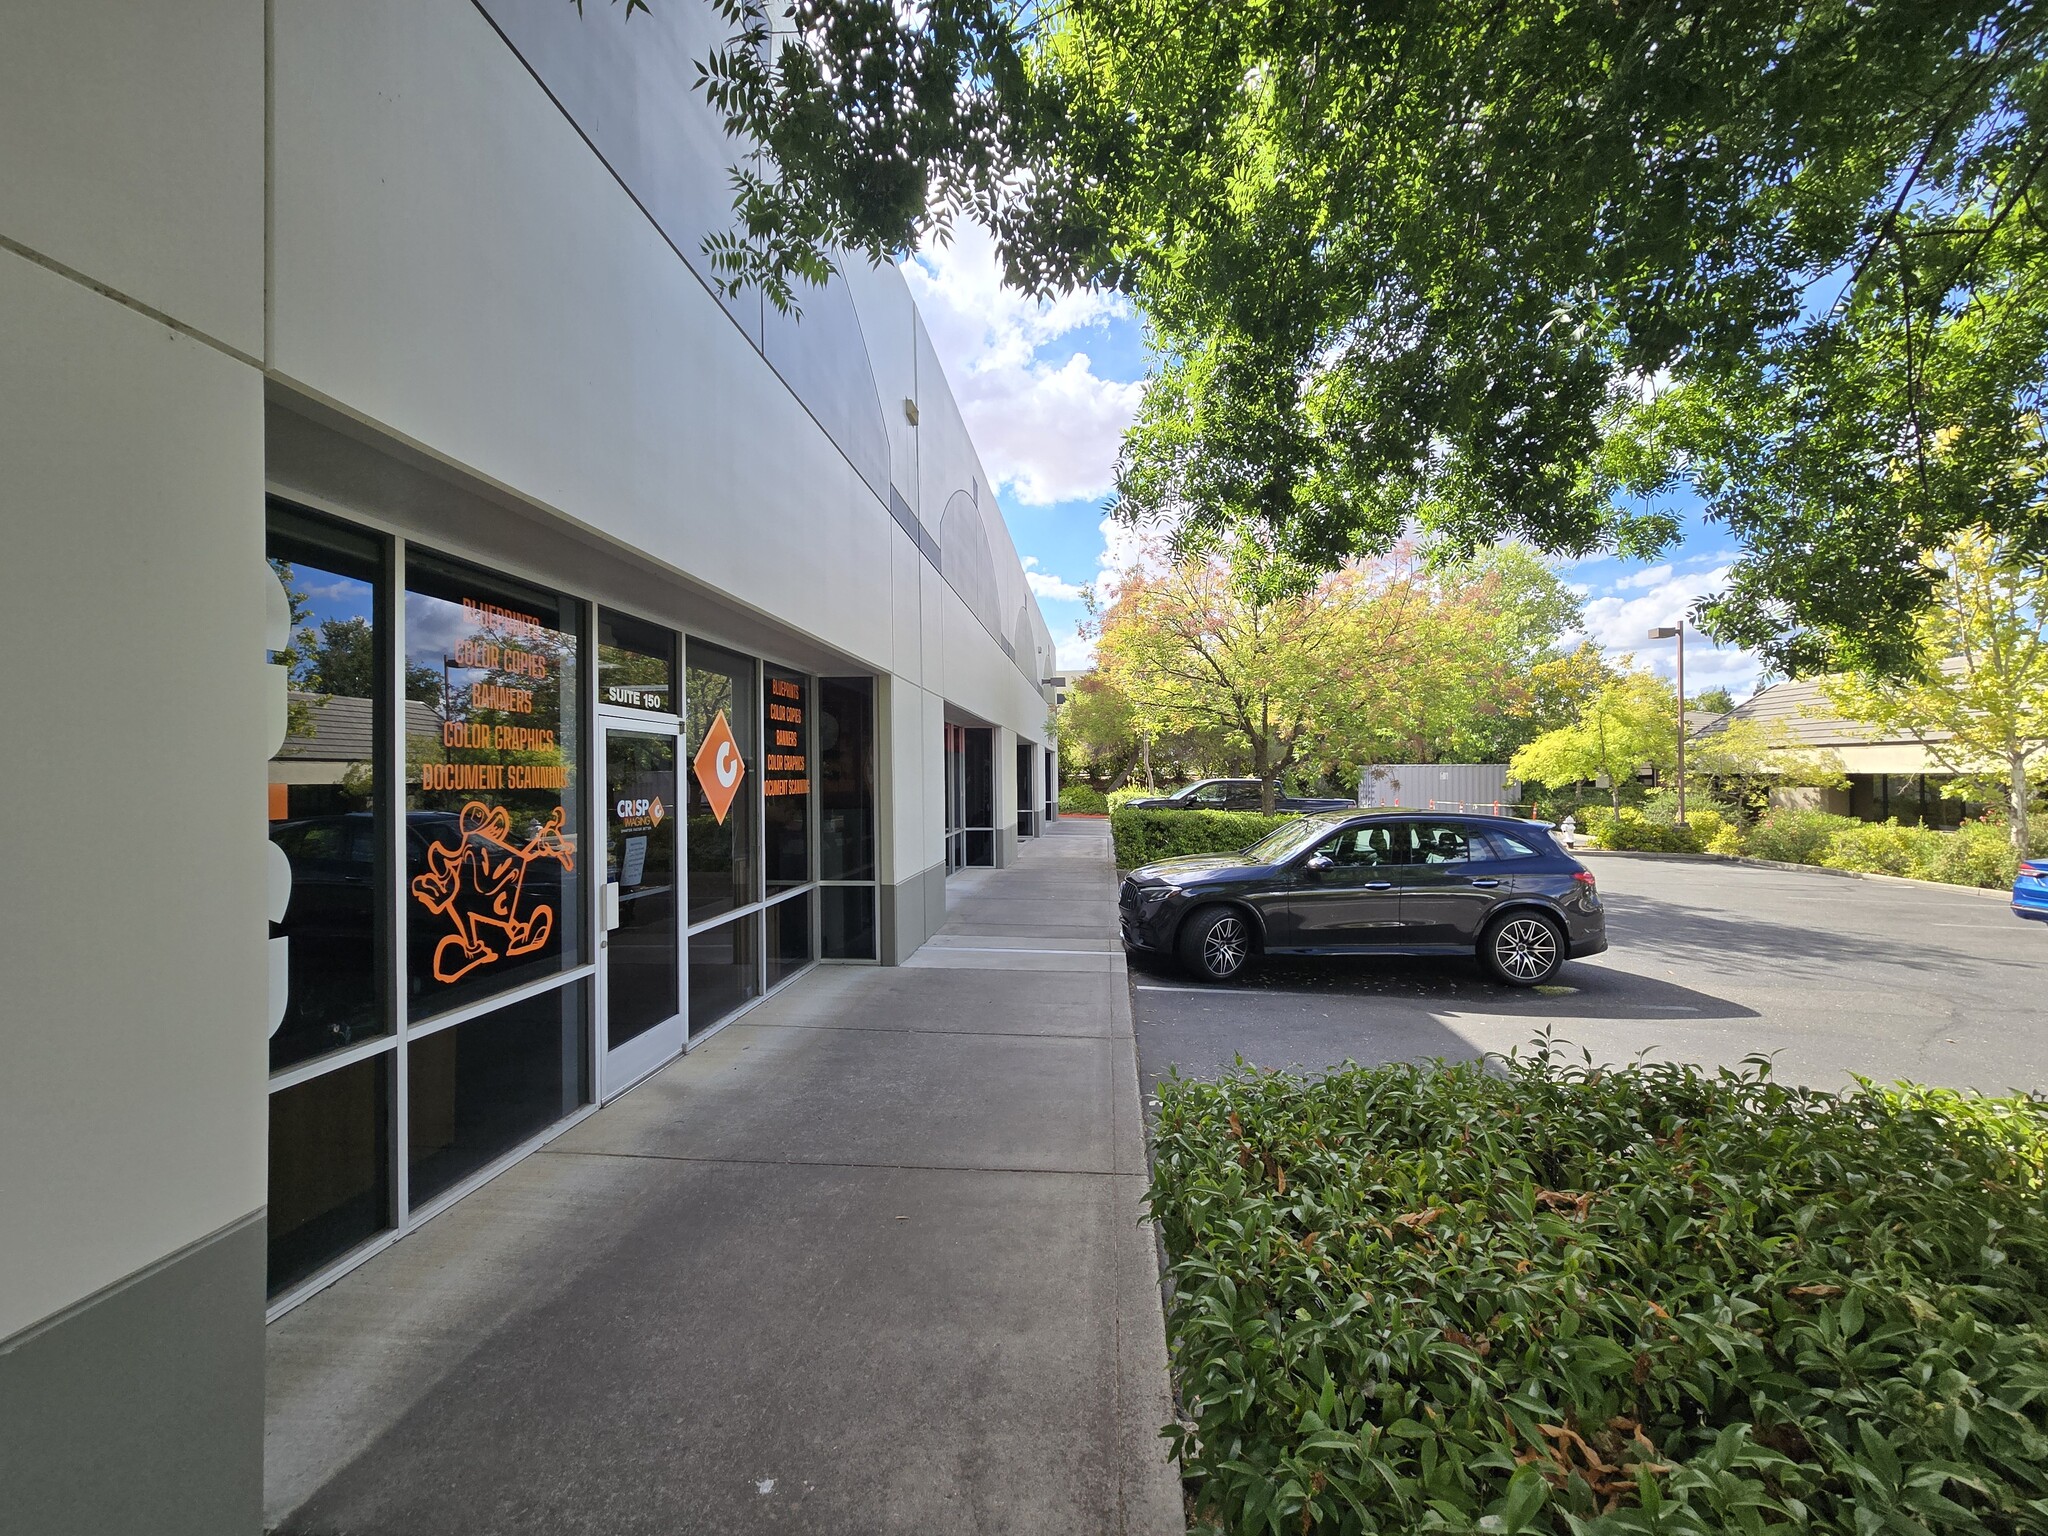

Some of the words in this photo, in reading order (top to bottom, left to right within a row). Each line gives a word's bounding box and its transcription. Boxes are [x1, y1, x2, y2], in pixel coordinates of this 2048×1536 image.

[463, 597, 541, 640] BLUEPRINTS
[455, 639, 499, 669] COLOR
[503, 649, 546, 679] COPIES
[472, 683, 533, 714] BANNERS
[609, 686, 641, 706] SUITE
[643, 693, 661, 709] 150
[443, 721, 491, 749] COLOR
[494, 726, 555, 752] GRAPHICS
[422, 764, 504, 791] DOCUMENT
[507, 765, 569, 790] SCANNING
[764, 779, 789, 796] OCUMENT
[617, 799, 649, 818] CRISP
[623, 815, 651, 828] IMAGING
